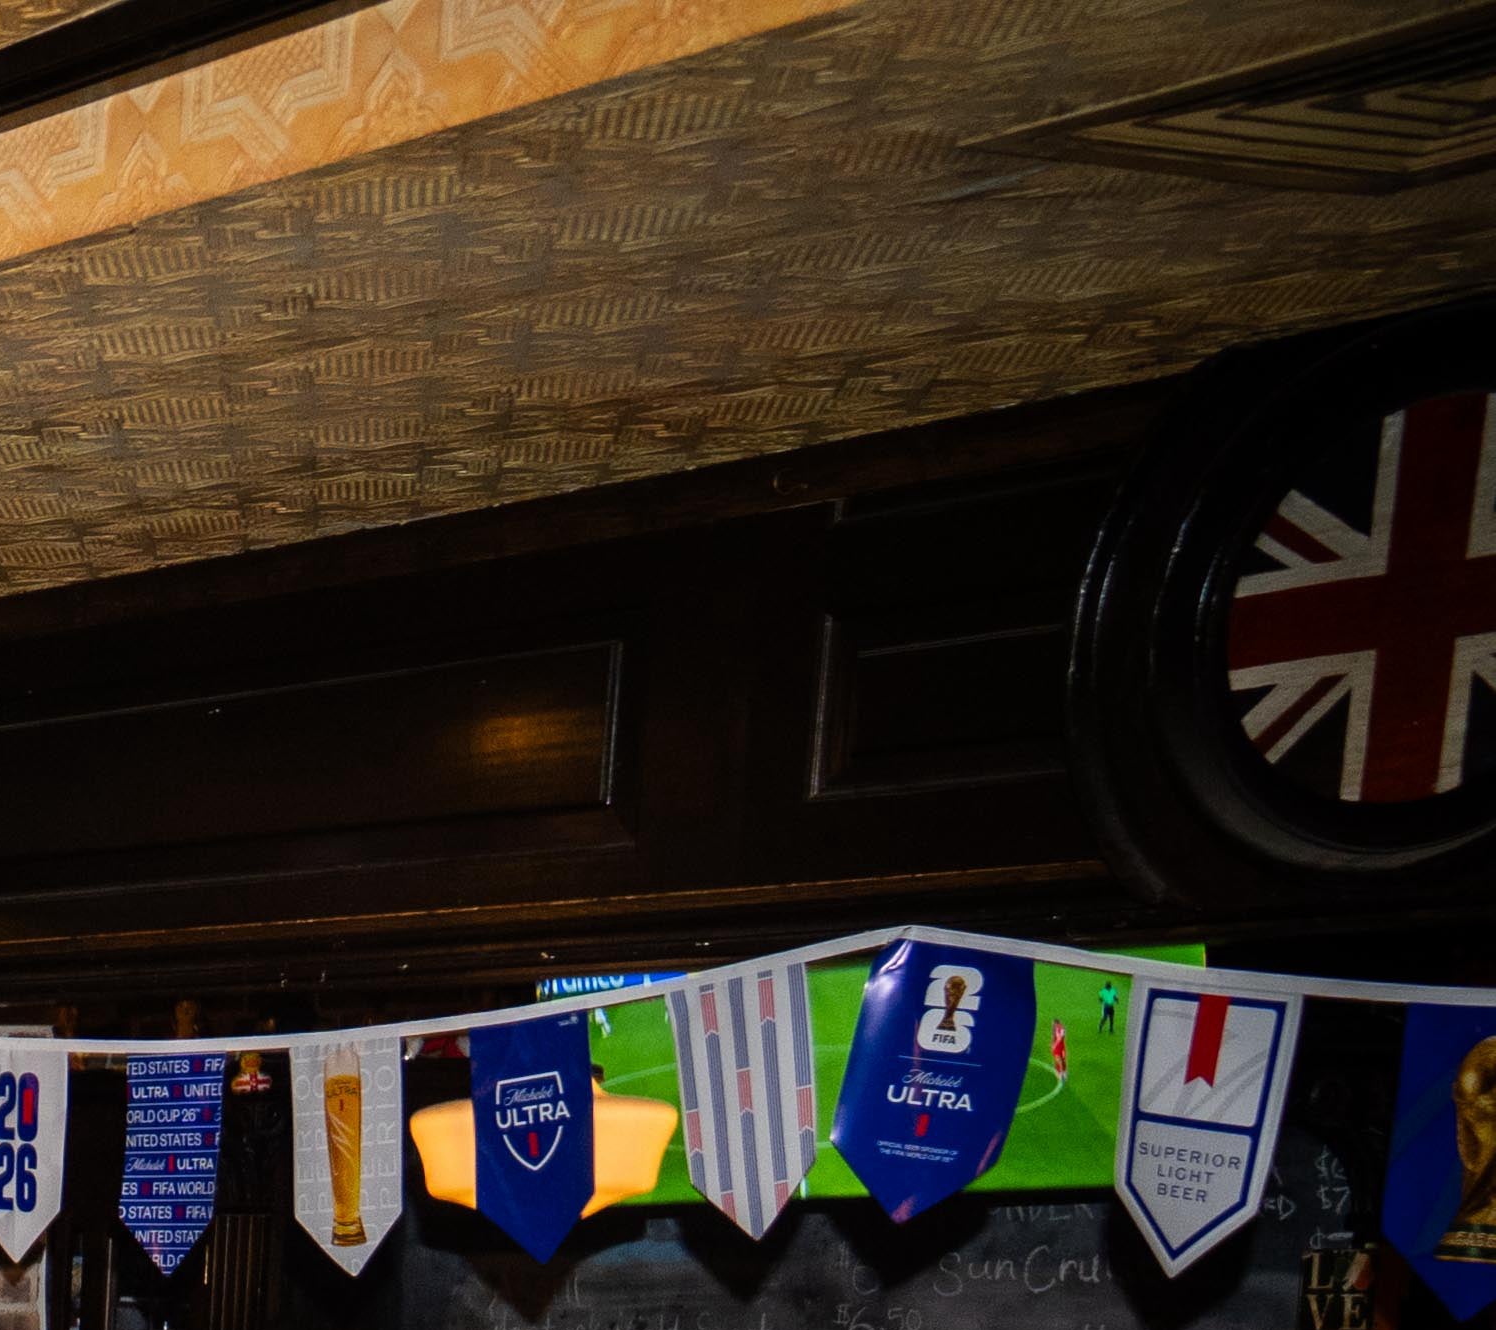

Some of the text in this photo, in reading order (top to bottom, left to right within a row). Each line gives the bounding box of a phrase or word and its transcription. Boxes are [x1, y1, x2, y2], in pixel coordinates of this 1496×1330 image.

[932, 1033, 957, 1045] FIFA
[148, 1060, 190, 1075] STATES
[132, 1085, 169, 1099] ULTRA
[886, 1084, 973, 1111] ULTRA
[126, 1109, 156, 1124] ORLD
[156, 1109, 180, 1123] CUP
[495, 1100, 571, 1129] ULTRA
[125, 1132, 202, 1148] NITED STATES
[1138, 1141, 1241, 1170] SUPERIOR
[176, 1157, 214, 1171] ULTRA
[1156, 1163, 1214, 1185] LIGHT
[152, 1182, 175, 1195] FIFA
[176, 1181, 216, 1195] WORLD
[1156, 1182, 1208, 1203] BEER
[128, 1205, 207, 1219] STATES FIFA
[151, 1253, 176, 1268] RLD
[932, 1250, 1017, 1298] Sun
